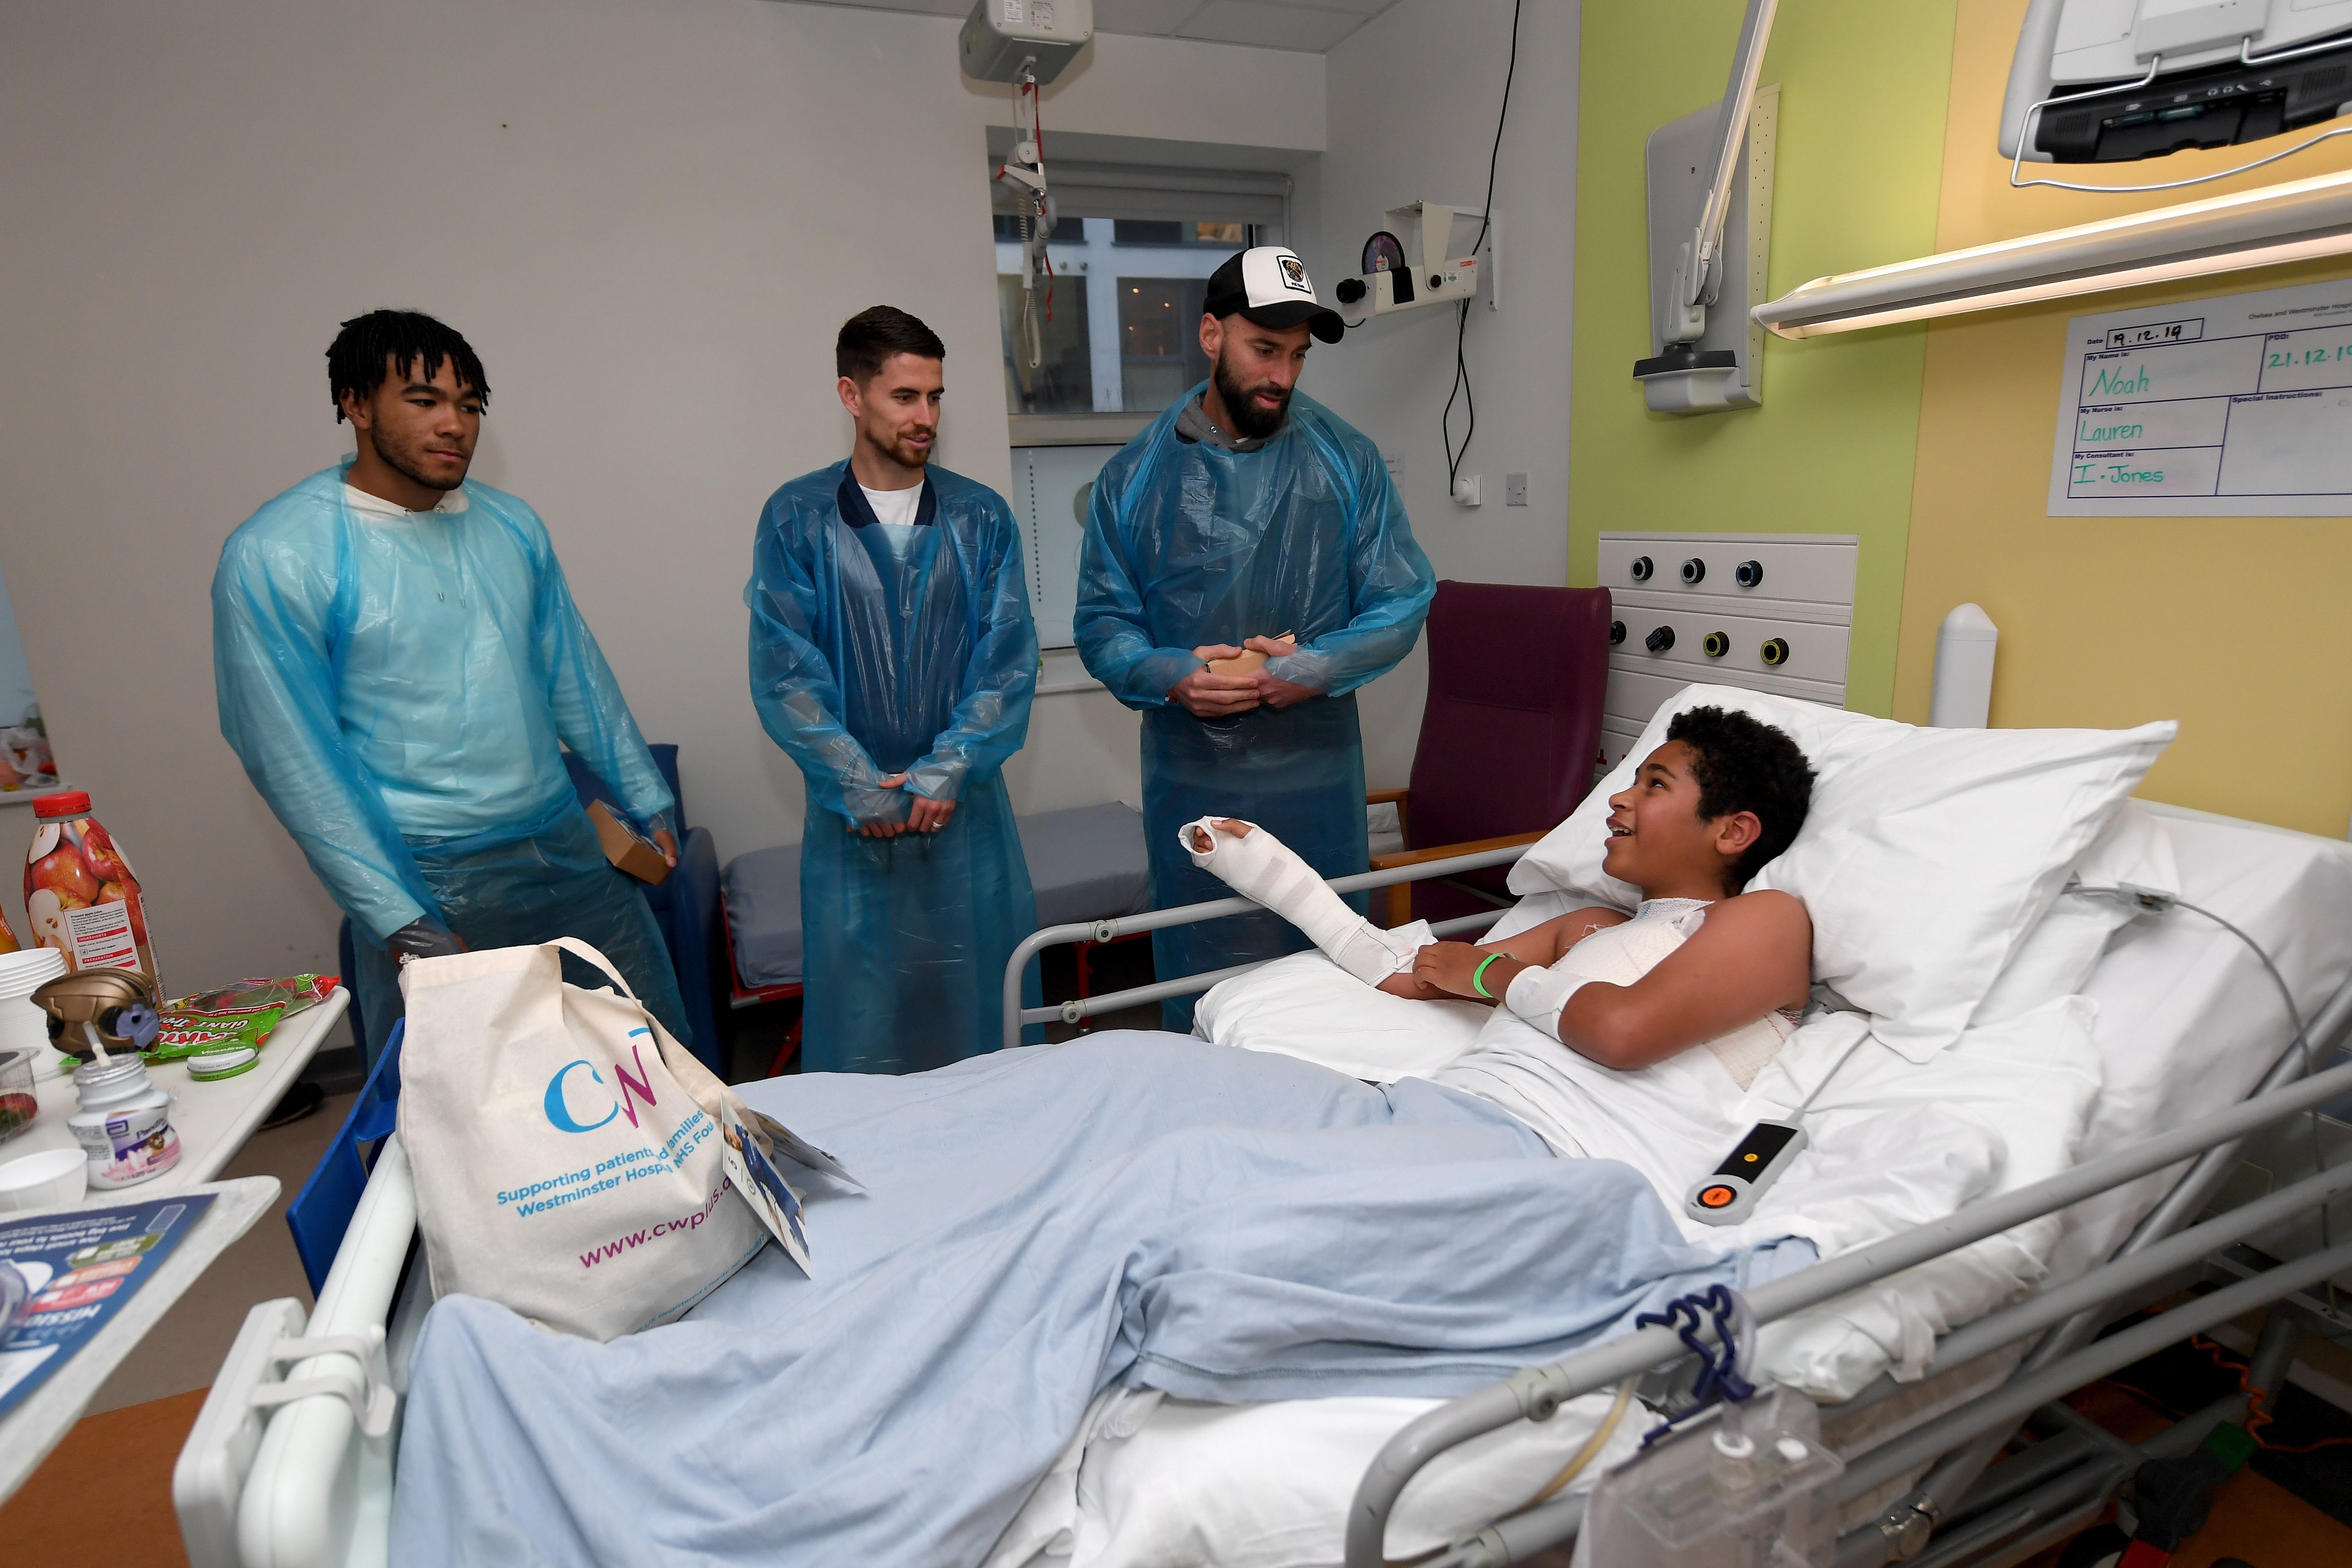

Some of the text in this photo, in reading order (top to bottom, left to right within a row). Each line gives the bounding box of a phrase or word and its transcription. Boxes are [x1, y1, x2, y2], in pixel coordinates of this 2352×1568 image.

[2088, 364, 2150, 397] Noah
[2232, 392, 2323, 404] Special Instructions:
[2080, 420, 2143, 442] Lauren
[2107, 464, 2165, 483] Jones
[79, 933, 107, 942] INGREDIENTS
[84, 954, 114, 962] PREPARATION
[194, 1019, 249, 1029] GIANT
[201, 1045, 247, 1055] Vaseline
[497, 1168, 590, 1205] Supporting
[517, 1175, 621, 1217] Westminster
